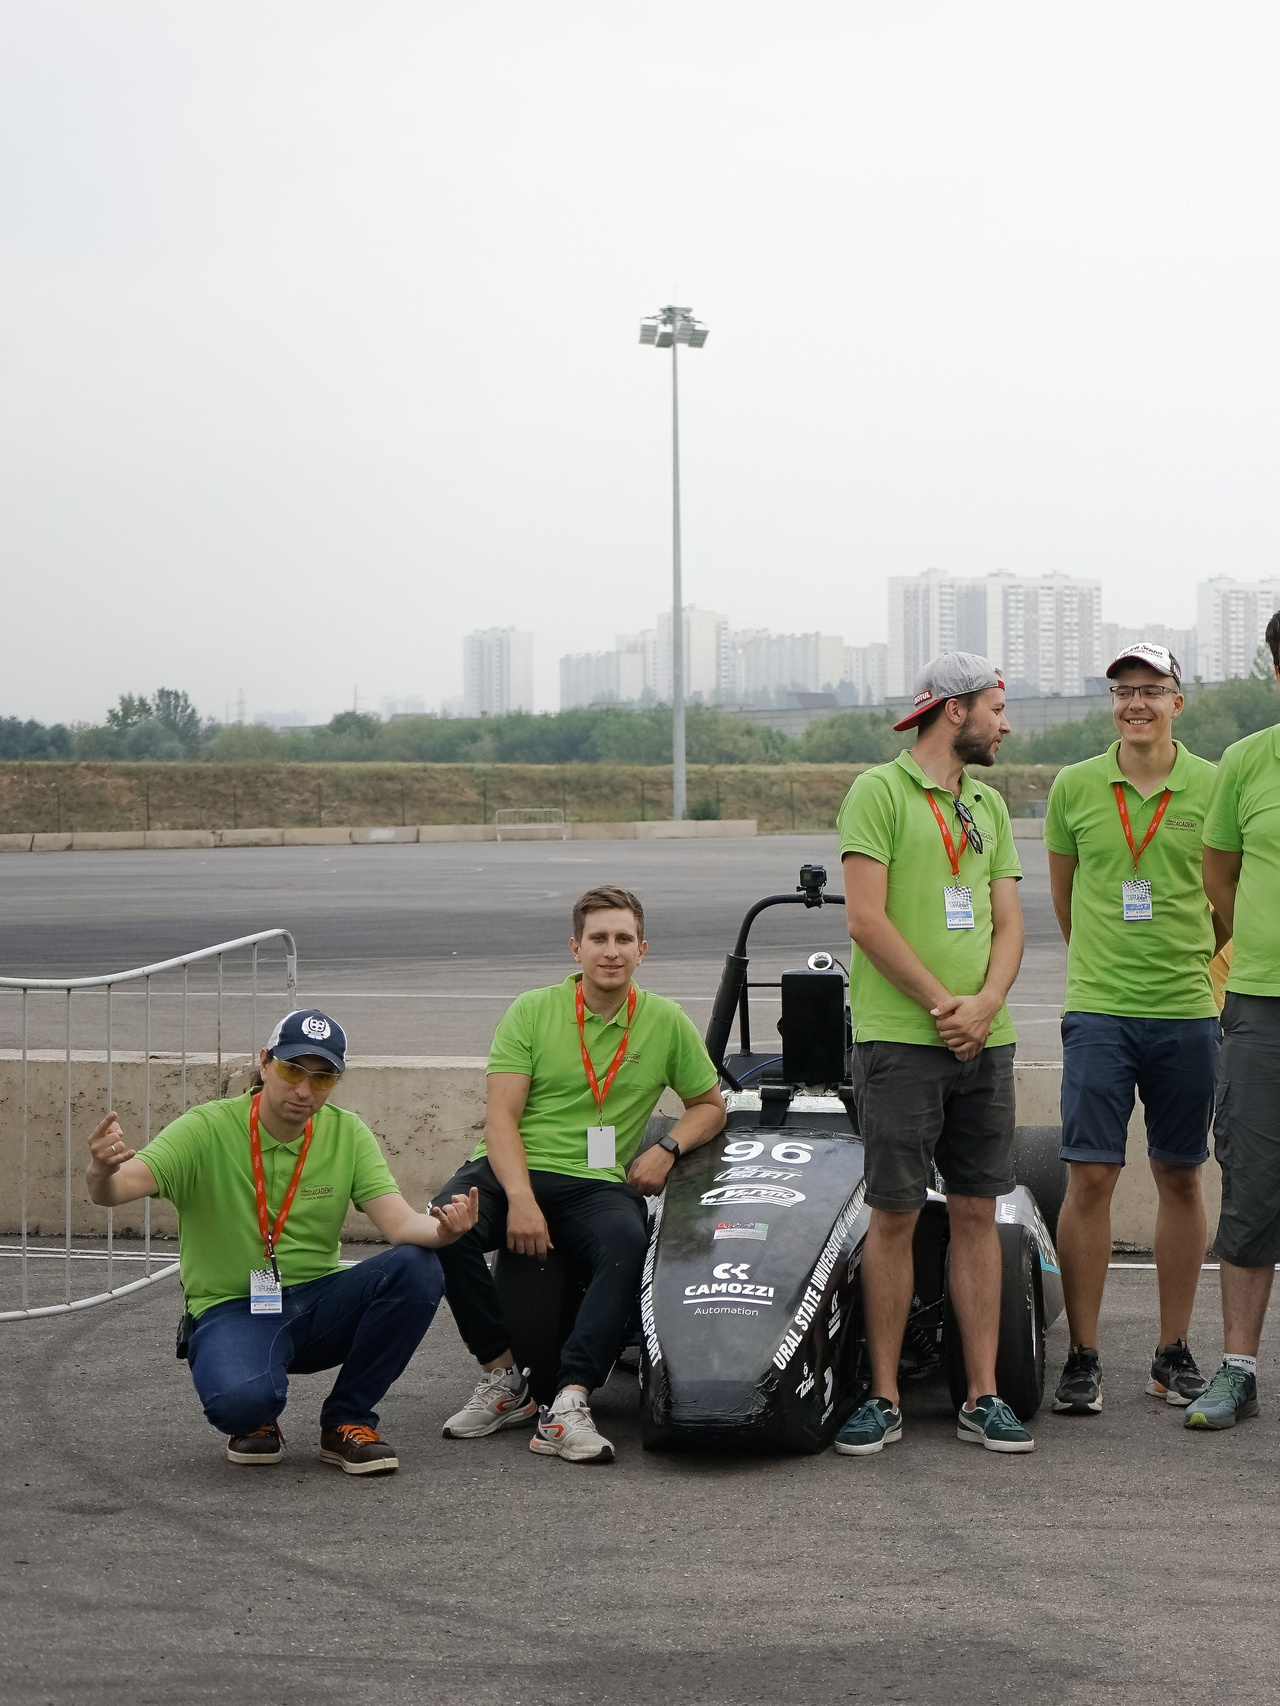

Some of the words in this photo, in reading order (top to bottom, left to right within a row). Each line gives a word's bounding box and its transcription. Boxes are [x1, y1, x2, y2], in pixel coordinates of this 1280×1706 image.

[720, 1140, 815, 1164] 96
[684, 1282, 775, 1298] CAMOZZI
[772, 1328, 803, 1371] URAL
[794, 1285, 822, 1332] STATE
[810, 1225, 843, 1291] UNIVERSITY
[836, 1217, 850, 1240] OF
[693, 1306, 759, 1316] Automation
[640, 1284, 663, 1367] TRANSPORT
